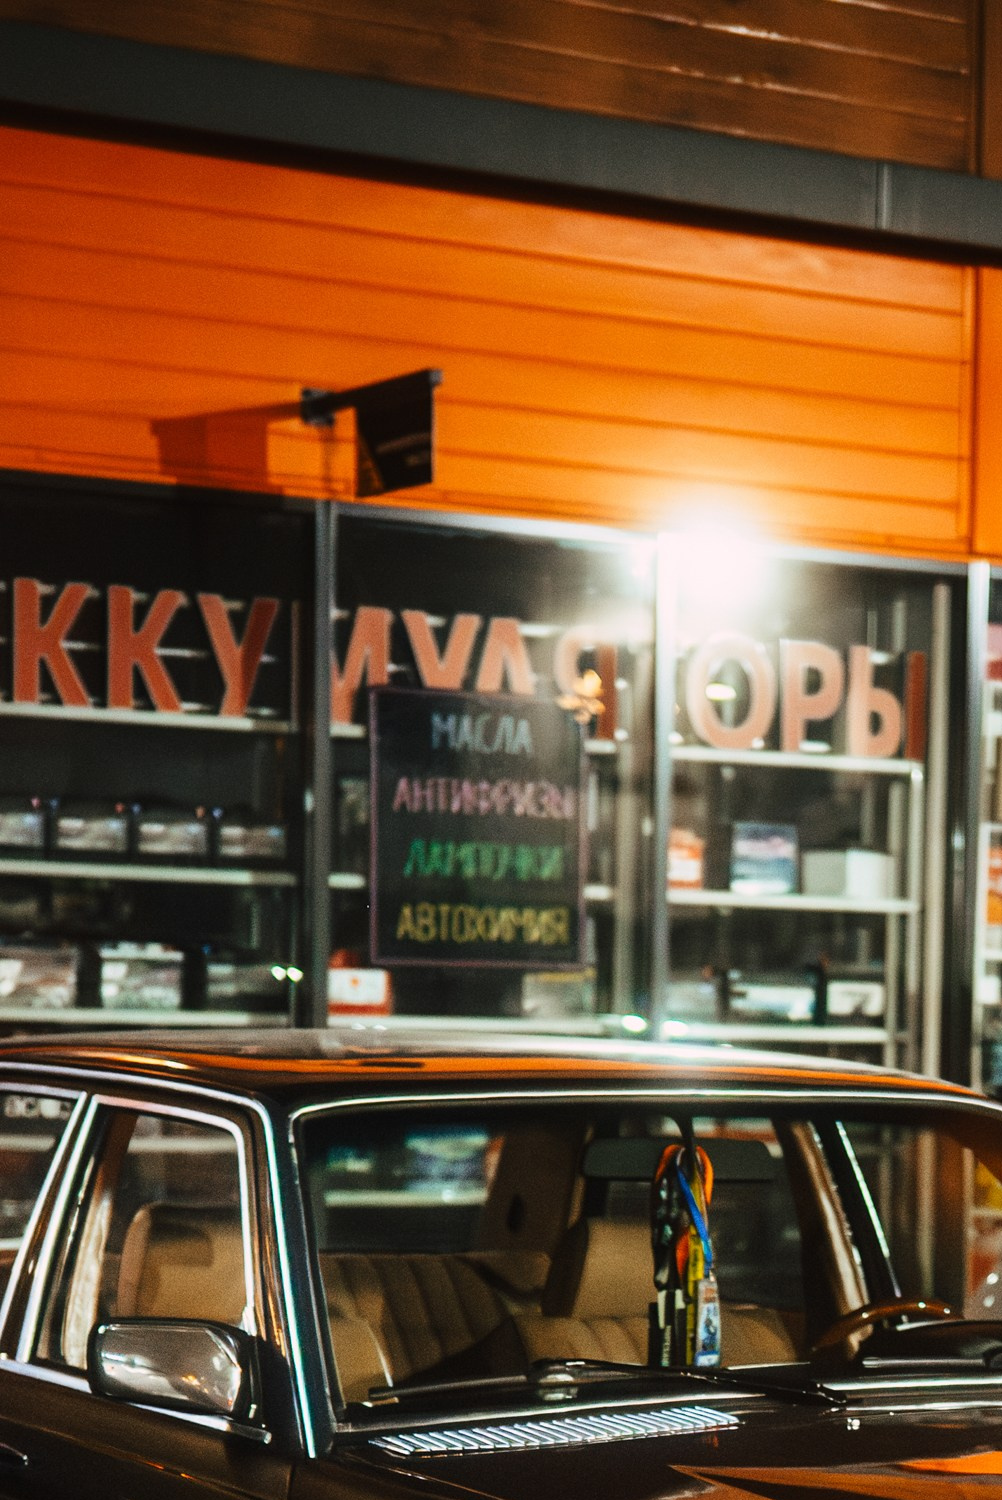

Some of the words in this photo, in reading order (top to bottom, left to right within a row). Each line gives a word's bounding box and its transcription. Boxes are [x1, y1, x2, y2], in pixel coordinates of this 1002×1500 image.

[12, 577, 928, 763] ККУМУЛЯОРЫ
[431, 711, 534, 755] МАСЛА
[396, 903, 571, 945] АВТОХИМИЯ
